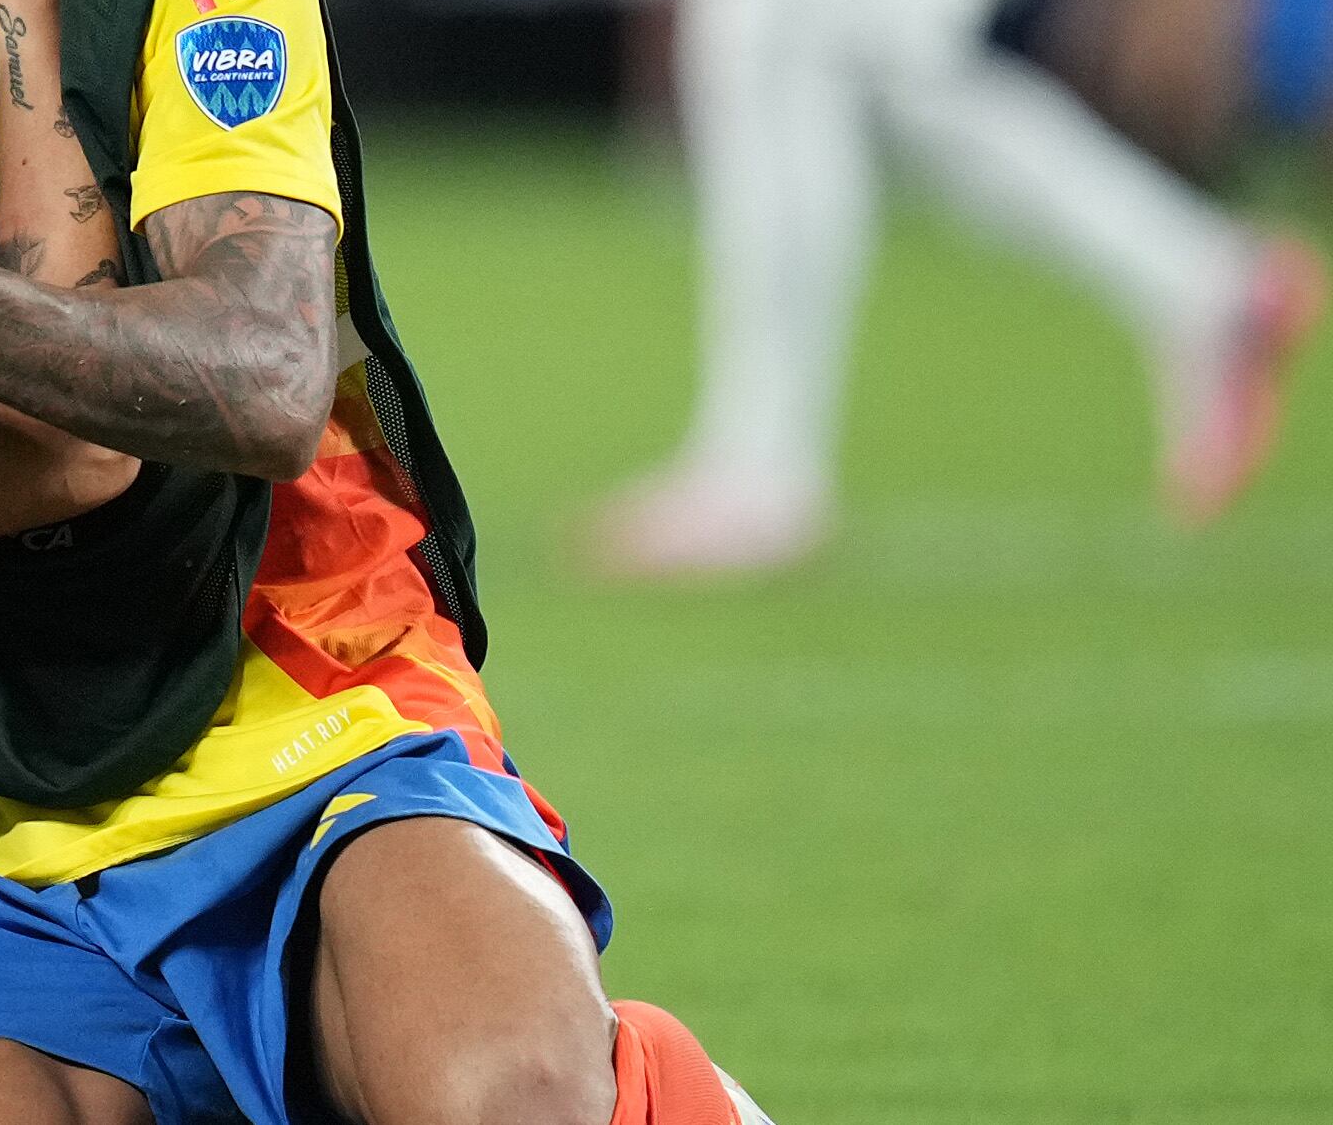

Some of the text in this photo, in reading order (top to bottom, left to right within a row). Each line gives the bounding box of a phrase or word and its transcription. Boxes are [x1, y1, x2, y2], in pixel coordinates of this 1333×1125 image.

[193, 48, 274, 72] VIBRA
[194, 72, 275, 83] EL CONTINENTE
[271, 706, 352, 775] HEAT.RDY
